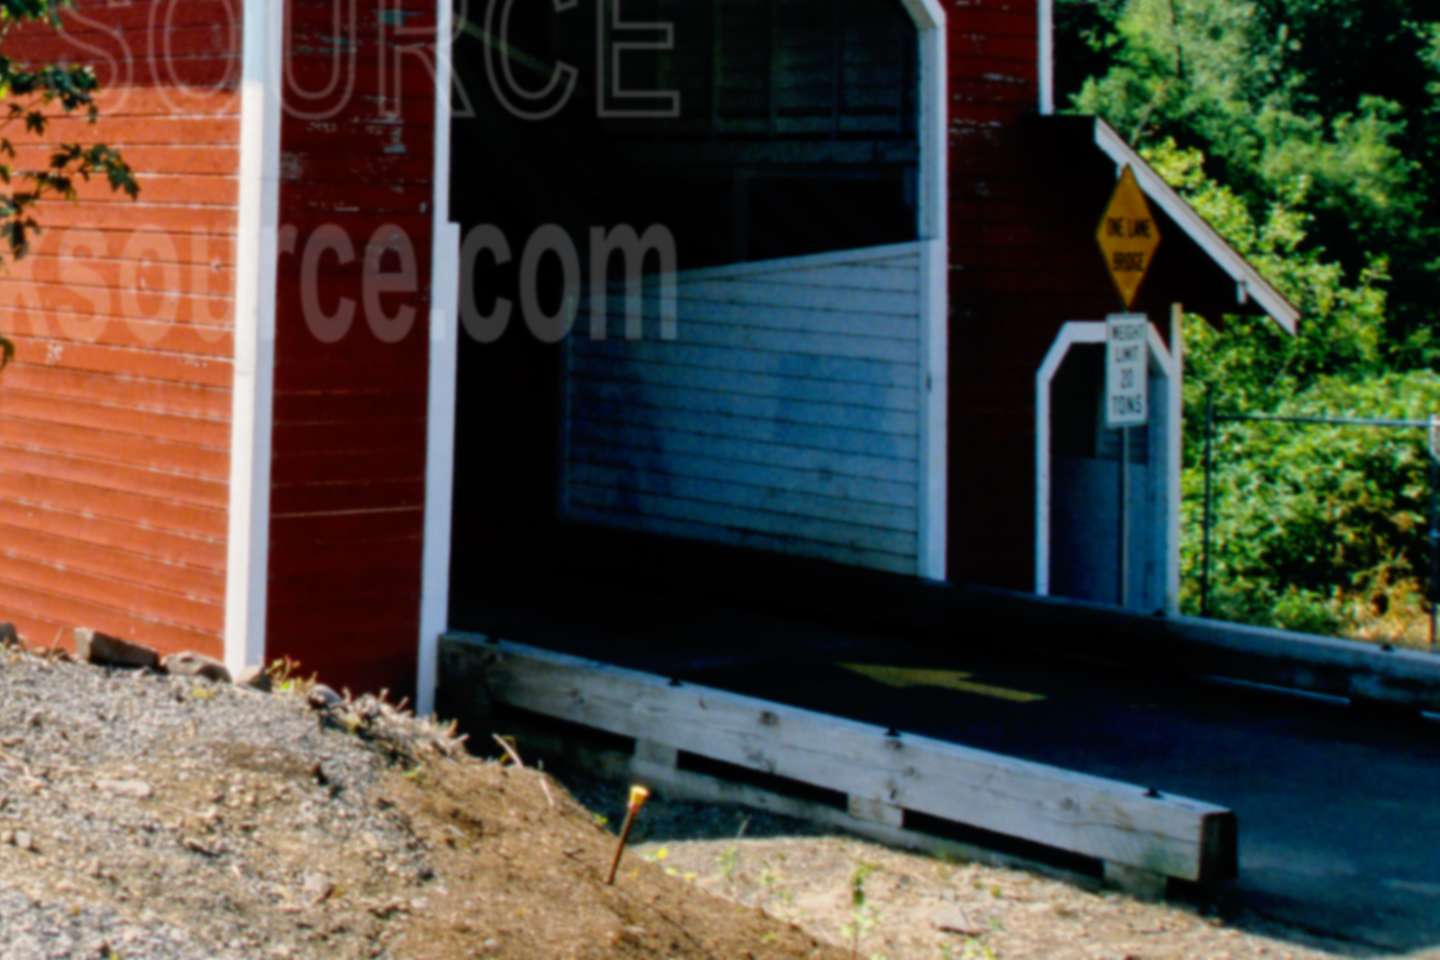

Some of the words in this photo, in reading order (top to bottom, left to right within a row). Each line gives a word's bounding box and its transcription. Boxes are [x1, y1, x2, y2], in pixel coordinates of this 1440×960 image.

[1112, 324, 1144, 341] WEIGHT
[1115, 345, 1139, 363] LIMIT
[1112, 395, 1142, 416] TONS
